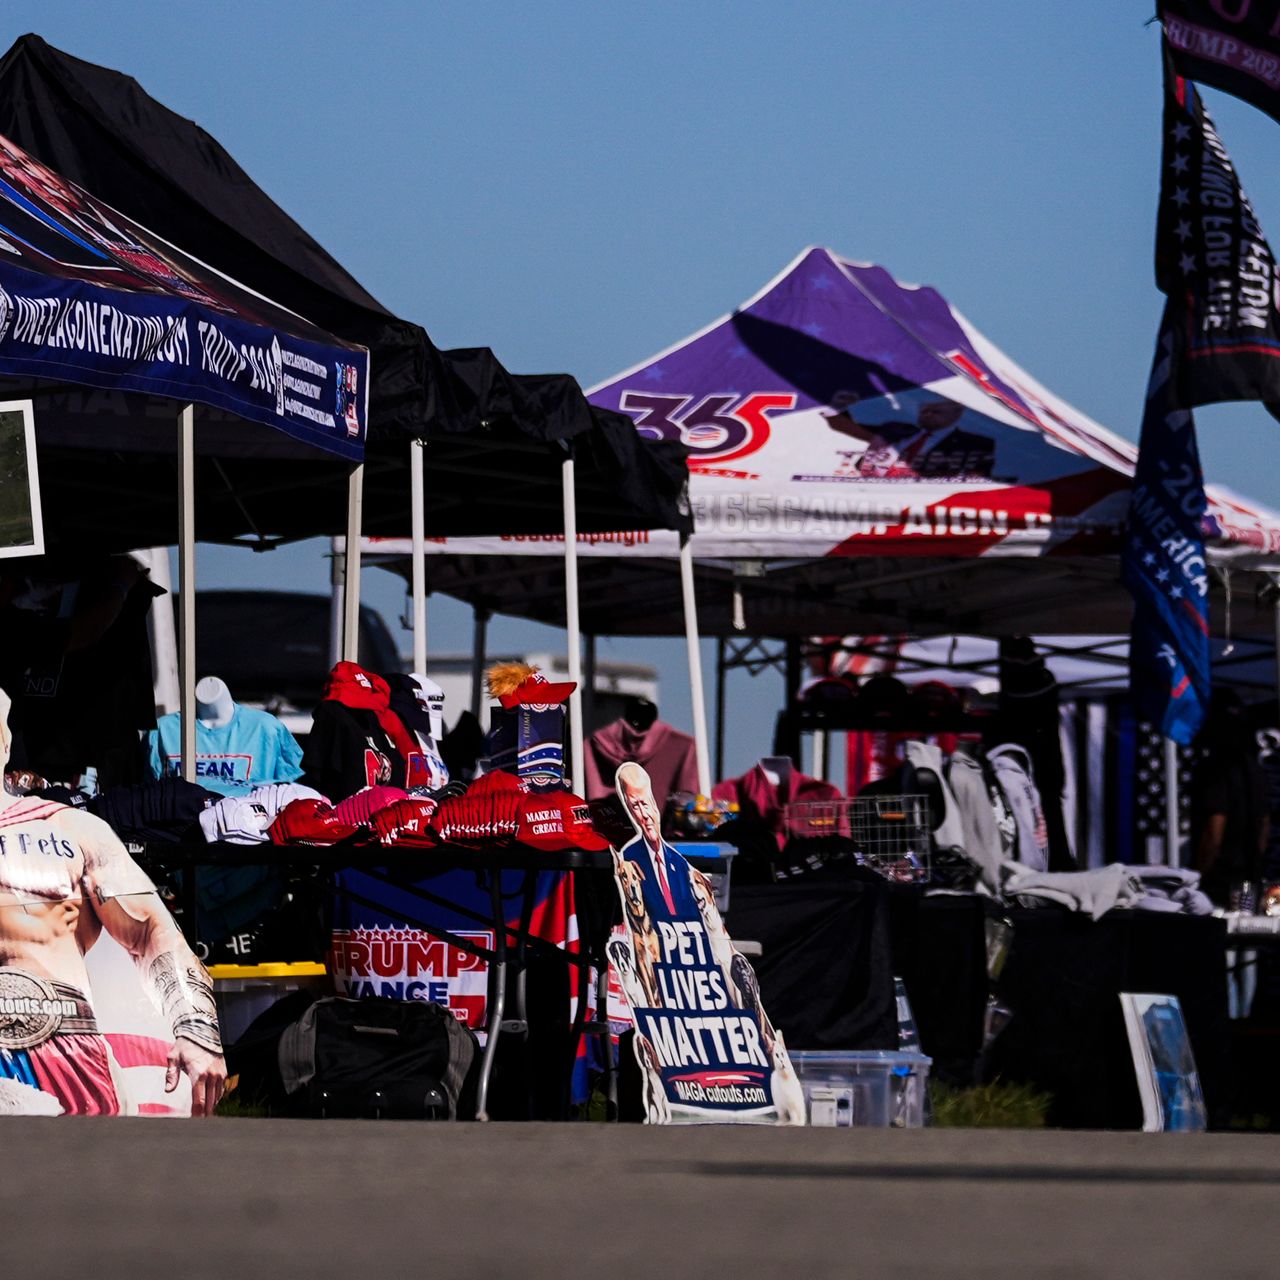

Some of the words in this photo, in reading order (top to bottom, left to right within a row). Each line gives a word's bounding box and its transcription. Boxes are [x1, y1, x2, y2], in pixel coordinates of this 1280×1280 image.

[620, 390, 798, 466] 365
[526, 810, 549, 823] MAKE
[20, 832, 75, 859] Pets
[657, 920, 707, 966] PET
[344, 980, 450, 1007] VANCE
[658, 968, 728, 1011] LIVES
[645, 1014, 769, 1068] MATTER
[675, 1080, 706, 1102] MAGA
[706, 1085, 767, 1103] cutouts.com
